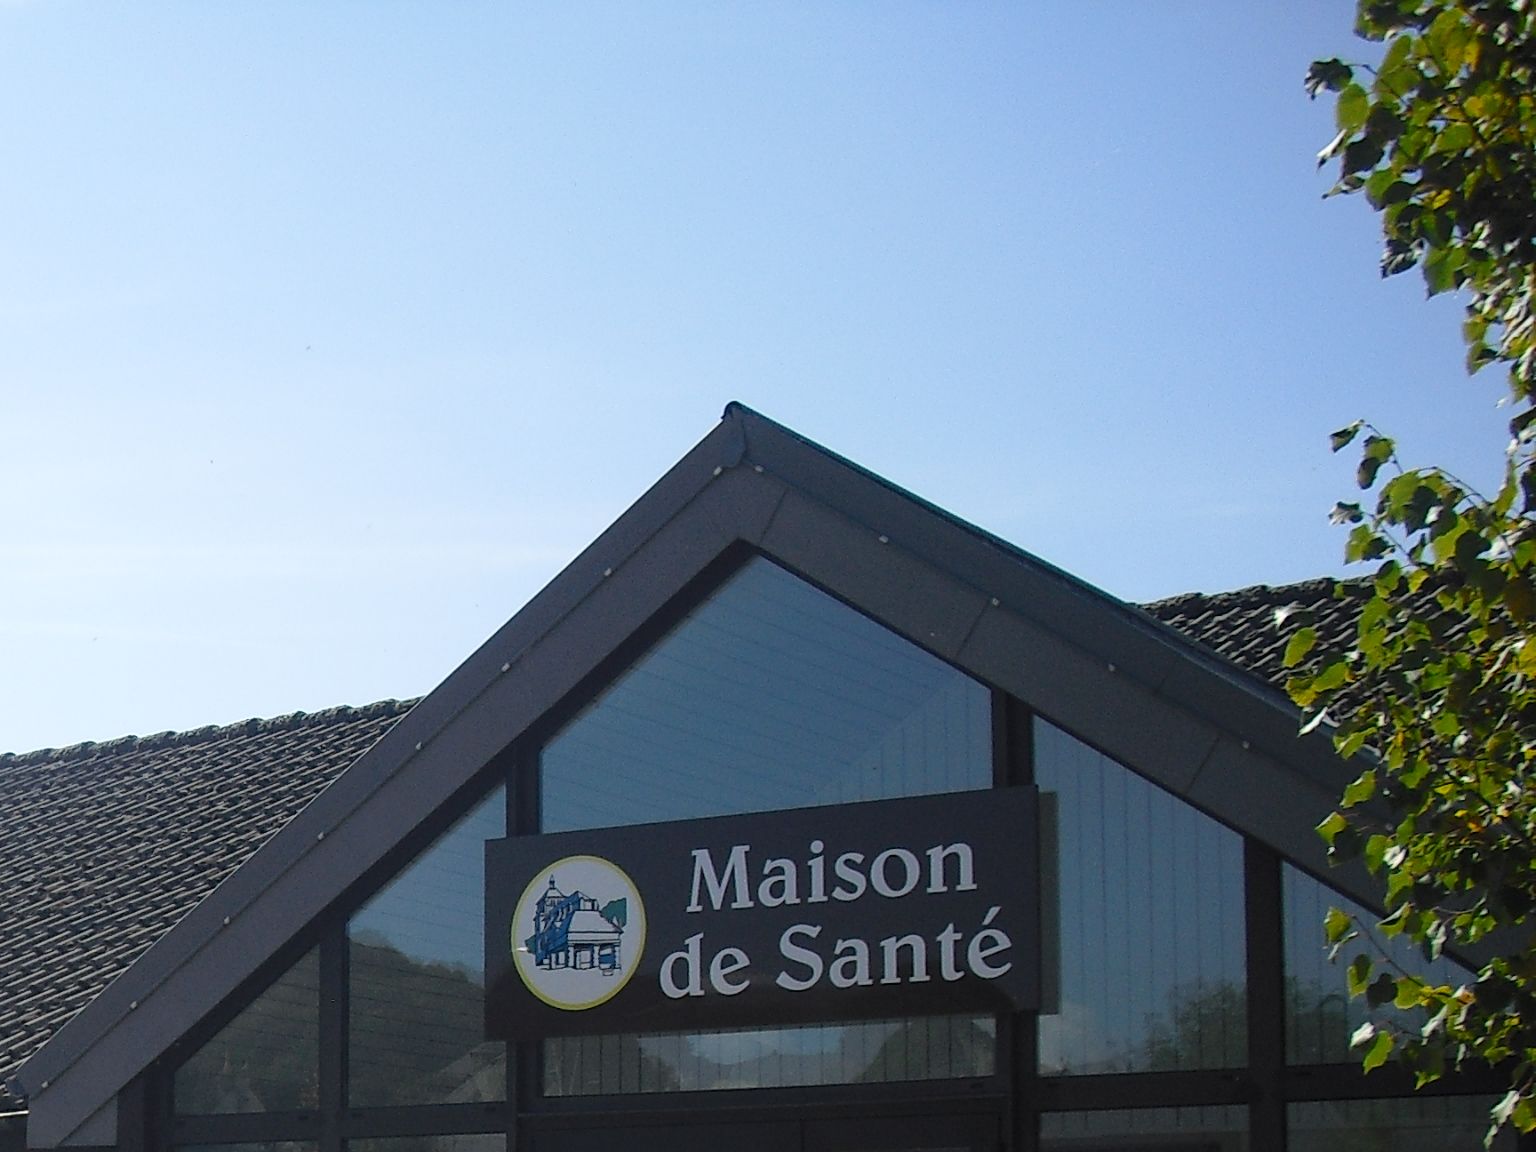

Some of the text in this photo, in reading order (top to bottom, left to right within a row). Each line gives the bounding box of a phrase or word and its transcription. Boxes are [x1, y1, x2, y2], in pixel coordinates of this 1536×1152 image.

[686, 839, 977, 913] Maison
[660, 907, 1013, 998] de Santé
